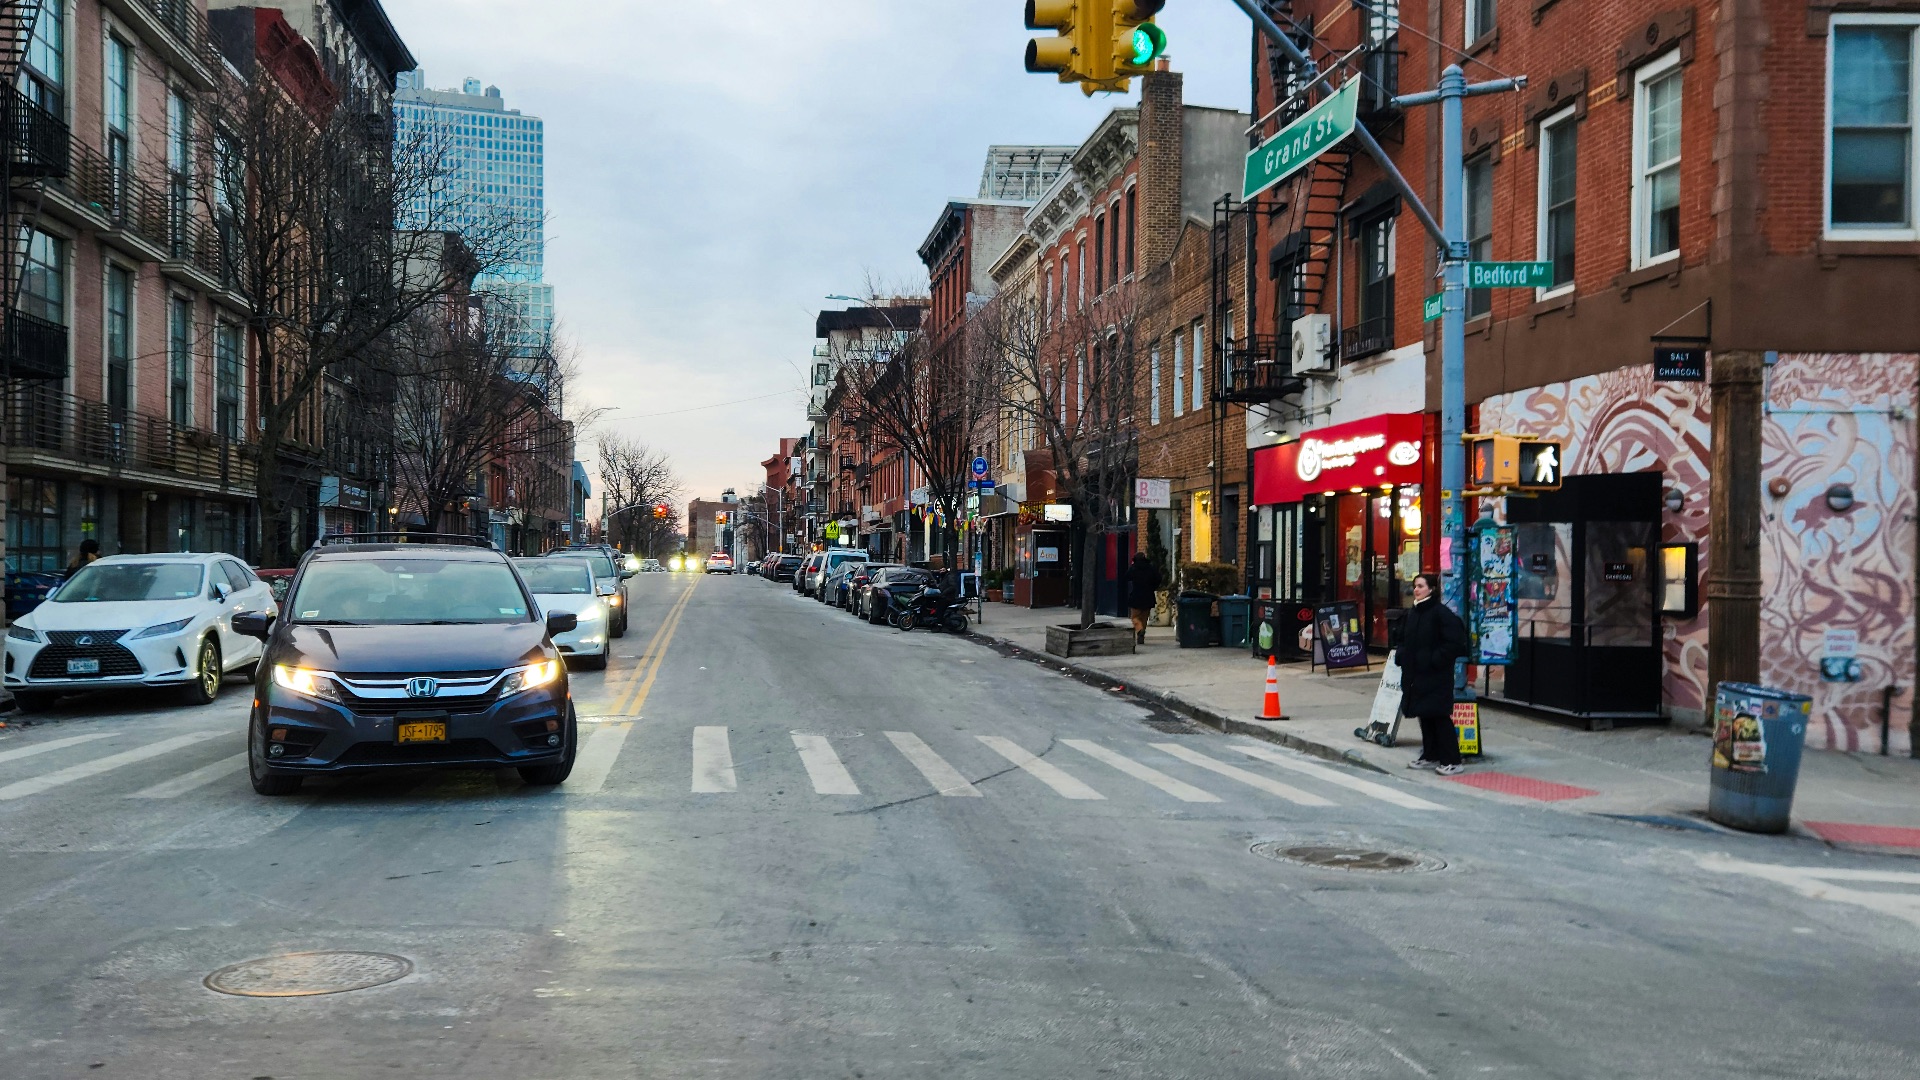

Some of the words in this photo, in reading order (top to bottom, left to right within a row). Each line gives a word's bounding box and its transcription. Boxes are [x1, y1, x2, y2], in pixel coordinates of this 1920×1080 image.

[1264, 124, 1313, 175] Grand
[1315, 108, 1334, 142] St
[1474, 265, 1527, 285] Bedford
[1532, 264, 1545, 276] Av
[1670, 352, 1690, 361] SALT
[1659, 367, 1702, 377] CHARCOAL
[424, 724, 444, 736] 1795
